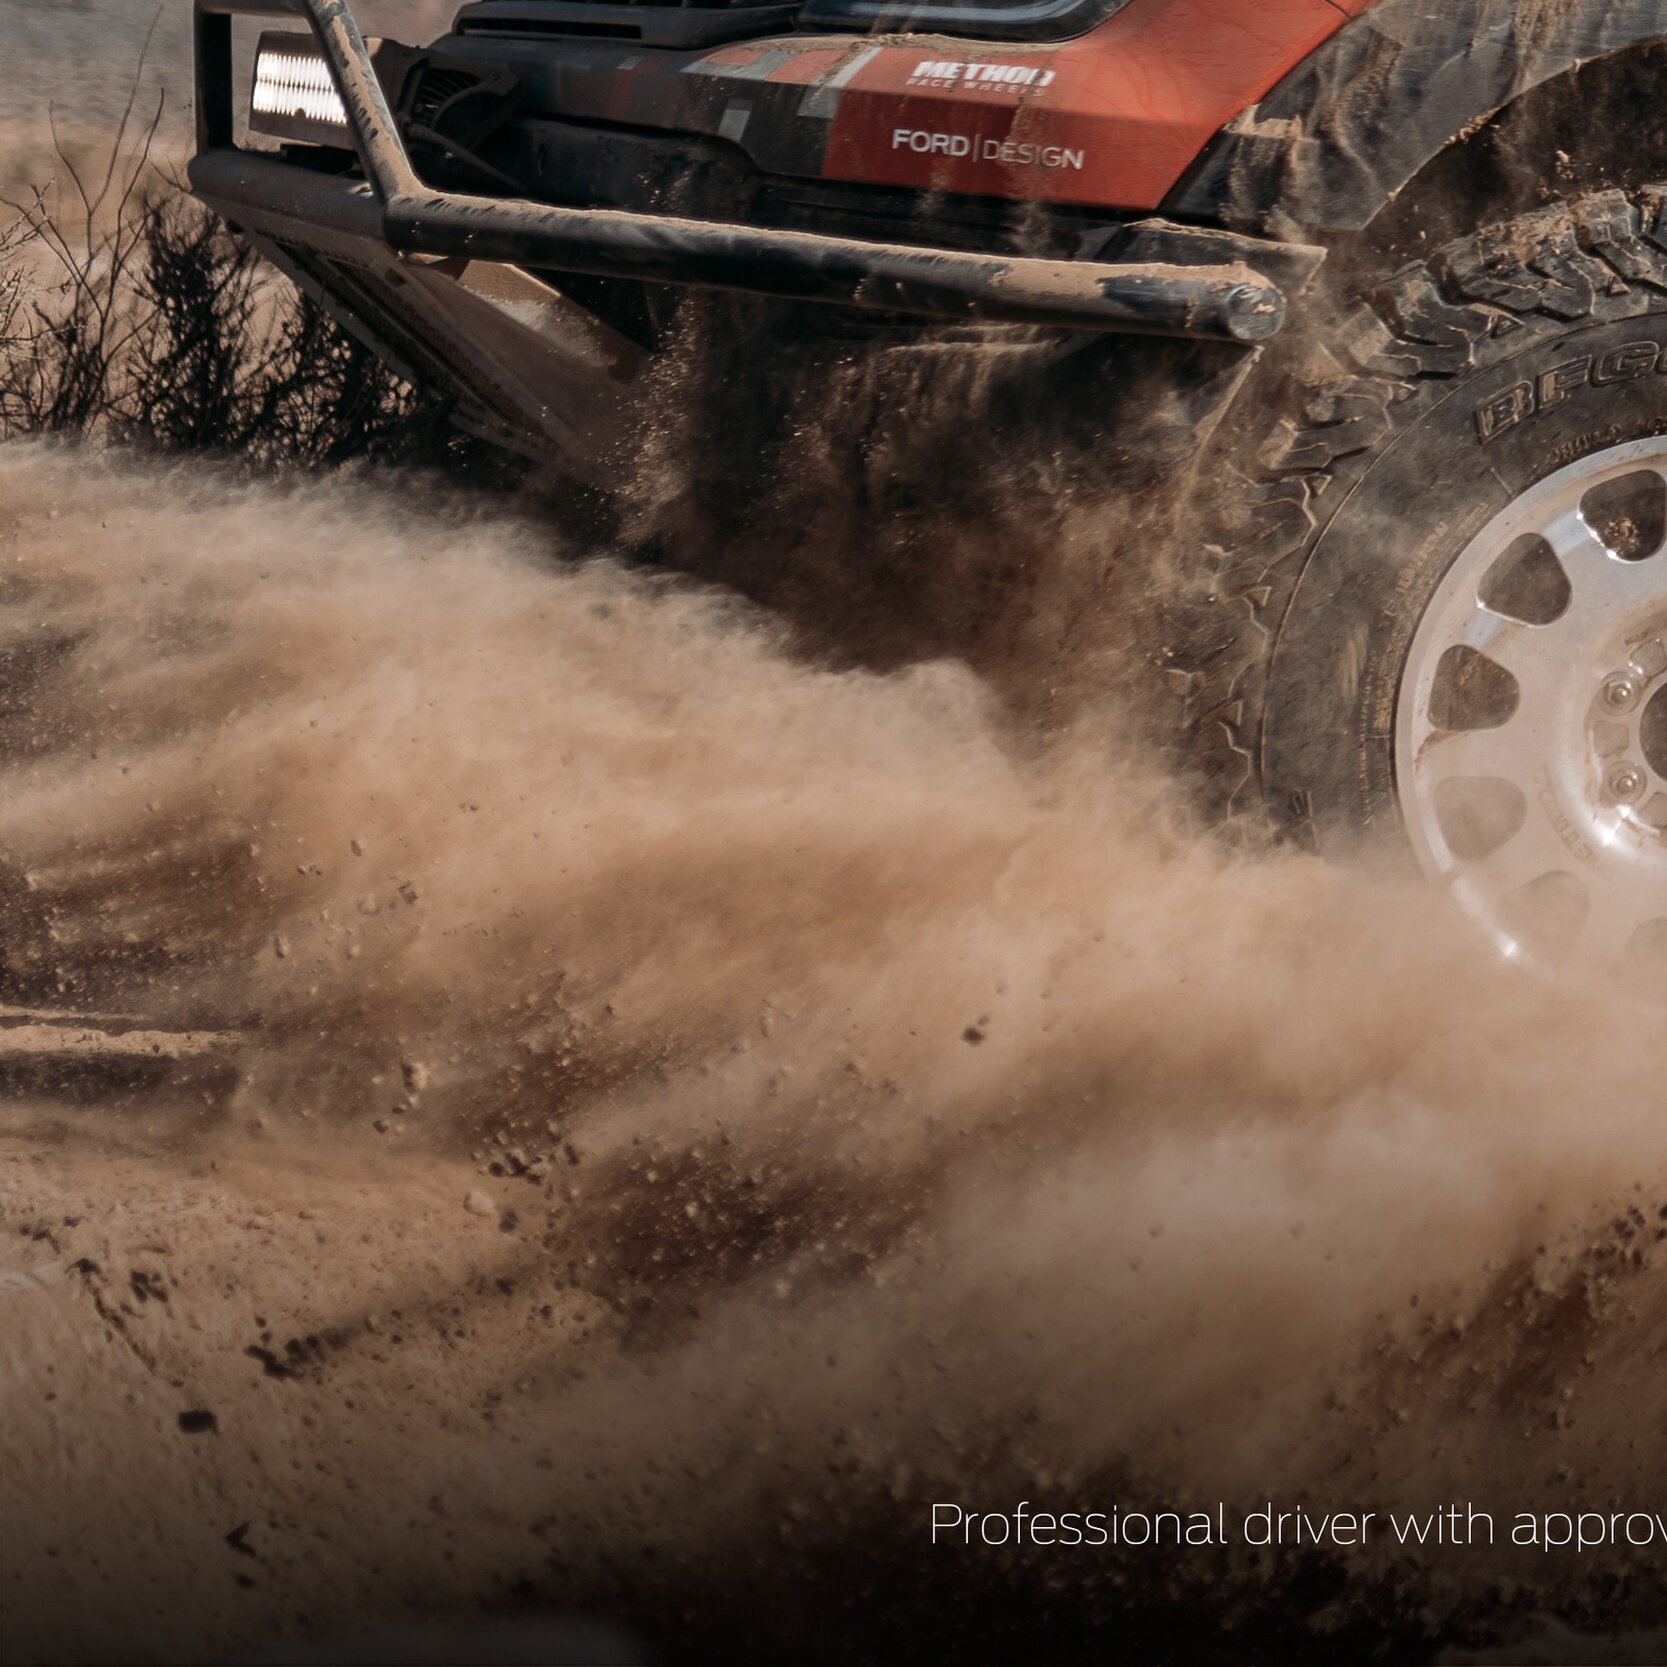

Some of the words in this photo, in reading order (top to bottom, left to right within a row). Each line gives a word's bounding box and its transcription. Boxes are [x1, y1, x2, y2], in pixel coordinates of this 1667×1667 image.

[905, 77, 955, 89] RACE
[911, 61, 1057, 87] METHOD
[891, 129, 970, 157] FORD
[982, 139, 1085, 171] DESIGN
